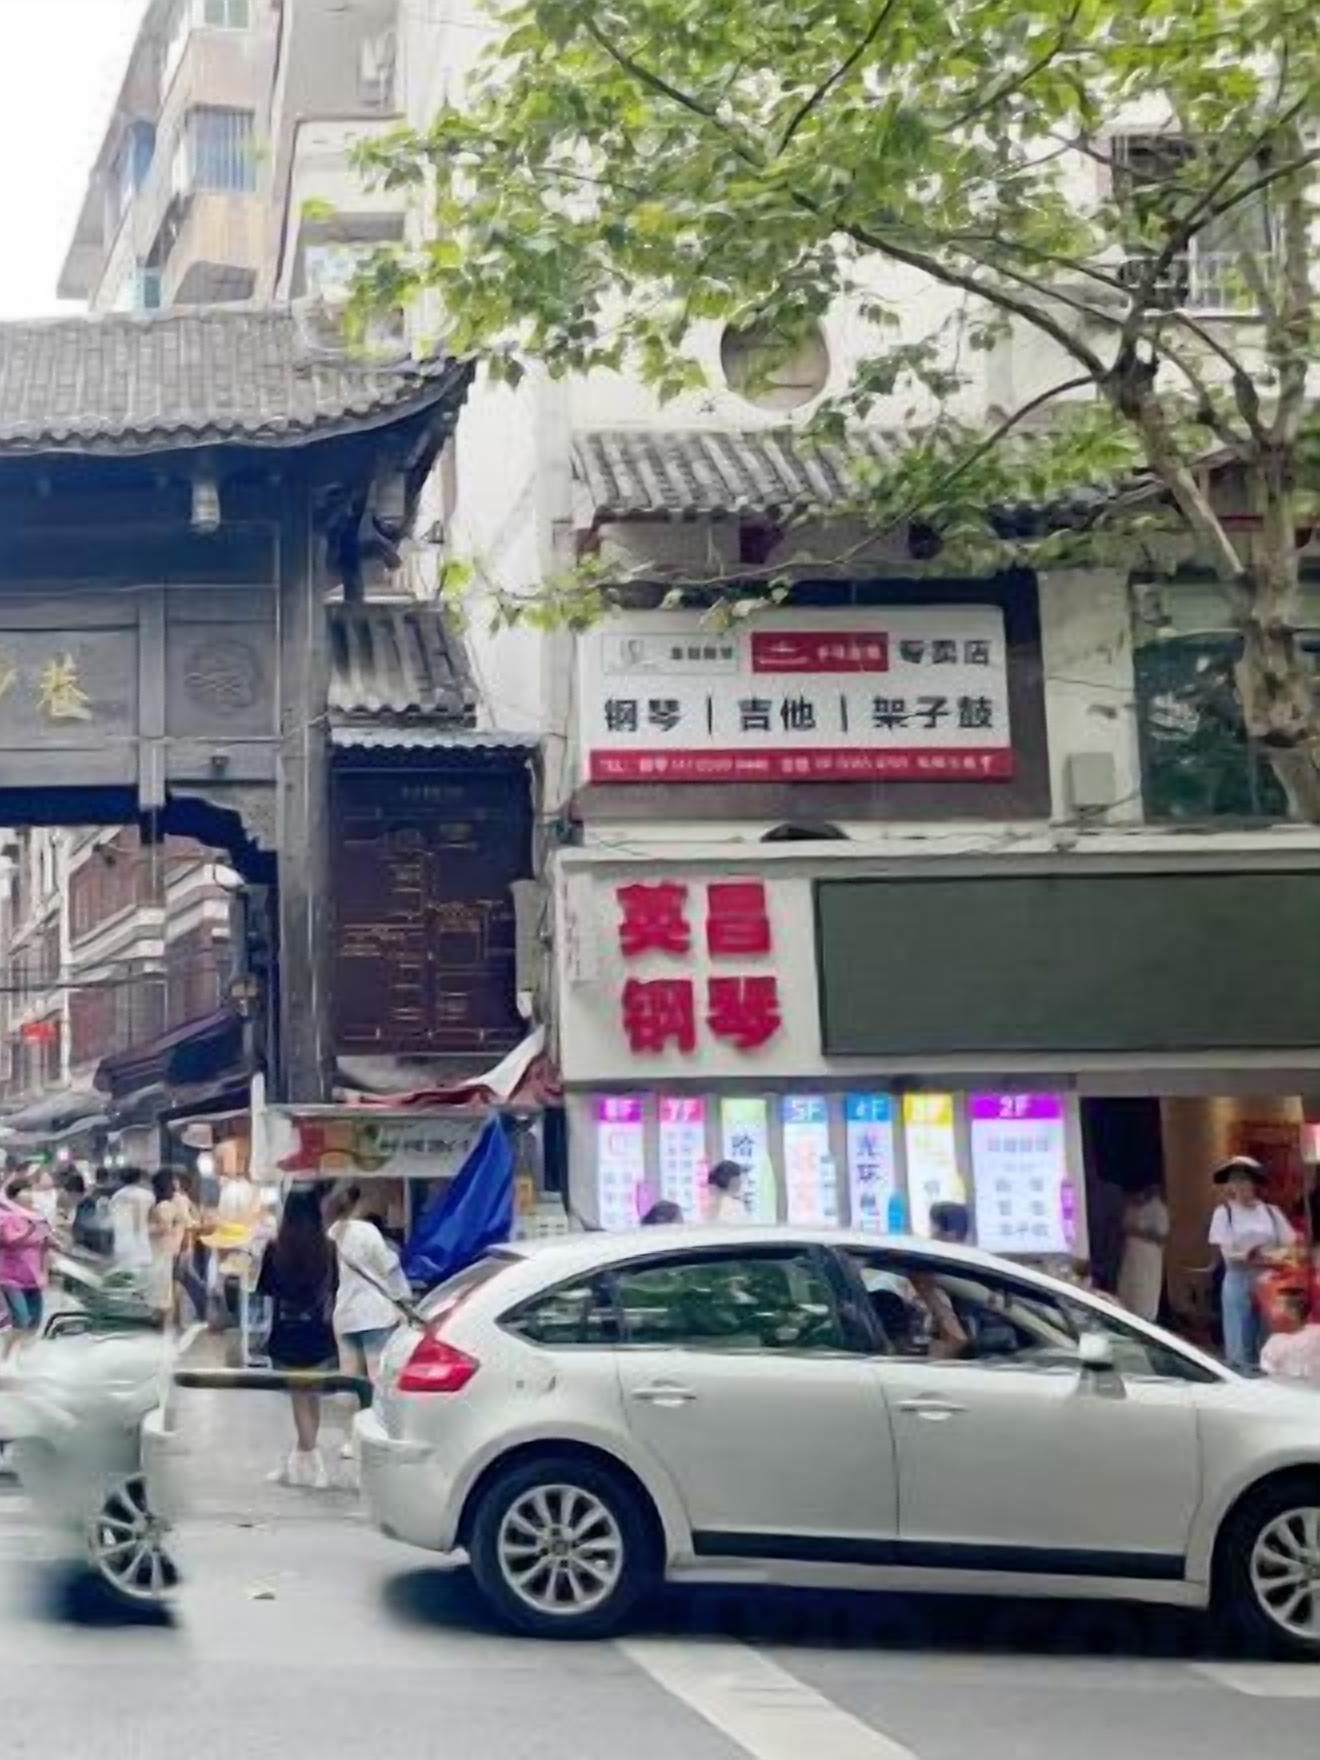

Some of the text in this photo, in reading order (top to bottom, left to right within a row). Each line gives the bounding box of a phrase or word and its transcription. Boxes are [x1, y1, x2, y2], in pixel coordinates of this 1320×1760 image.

[604, 694, 994, 733] 钢琴 吉他 架子鼓
[621, 974, 783, 1054] 钢琴
